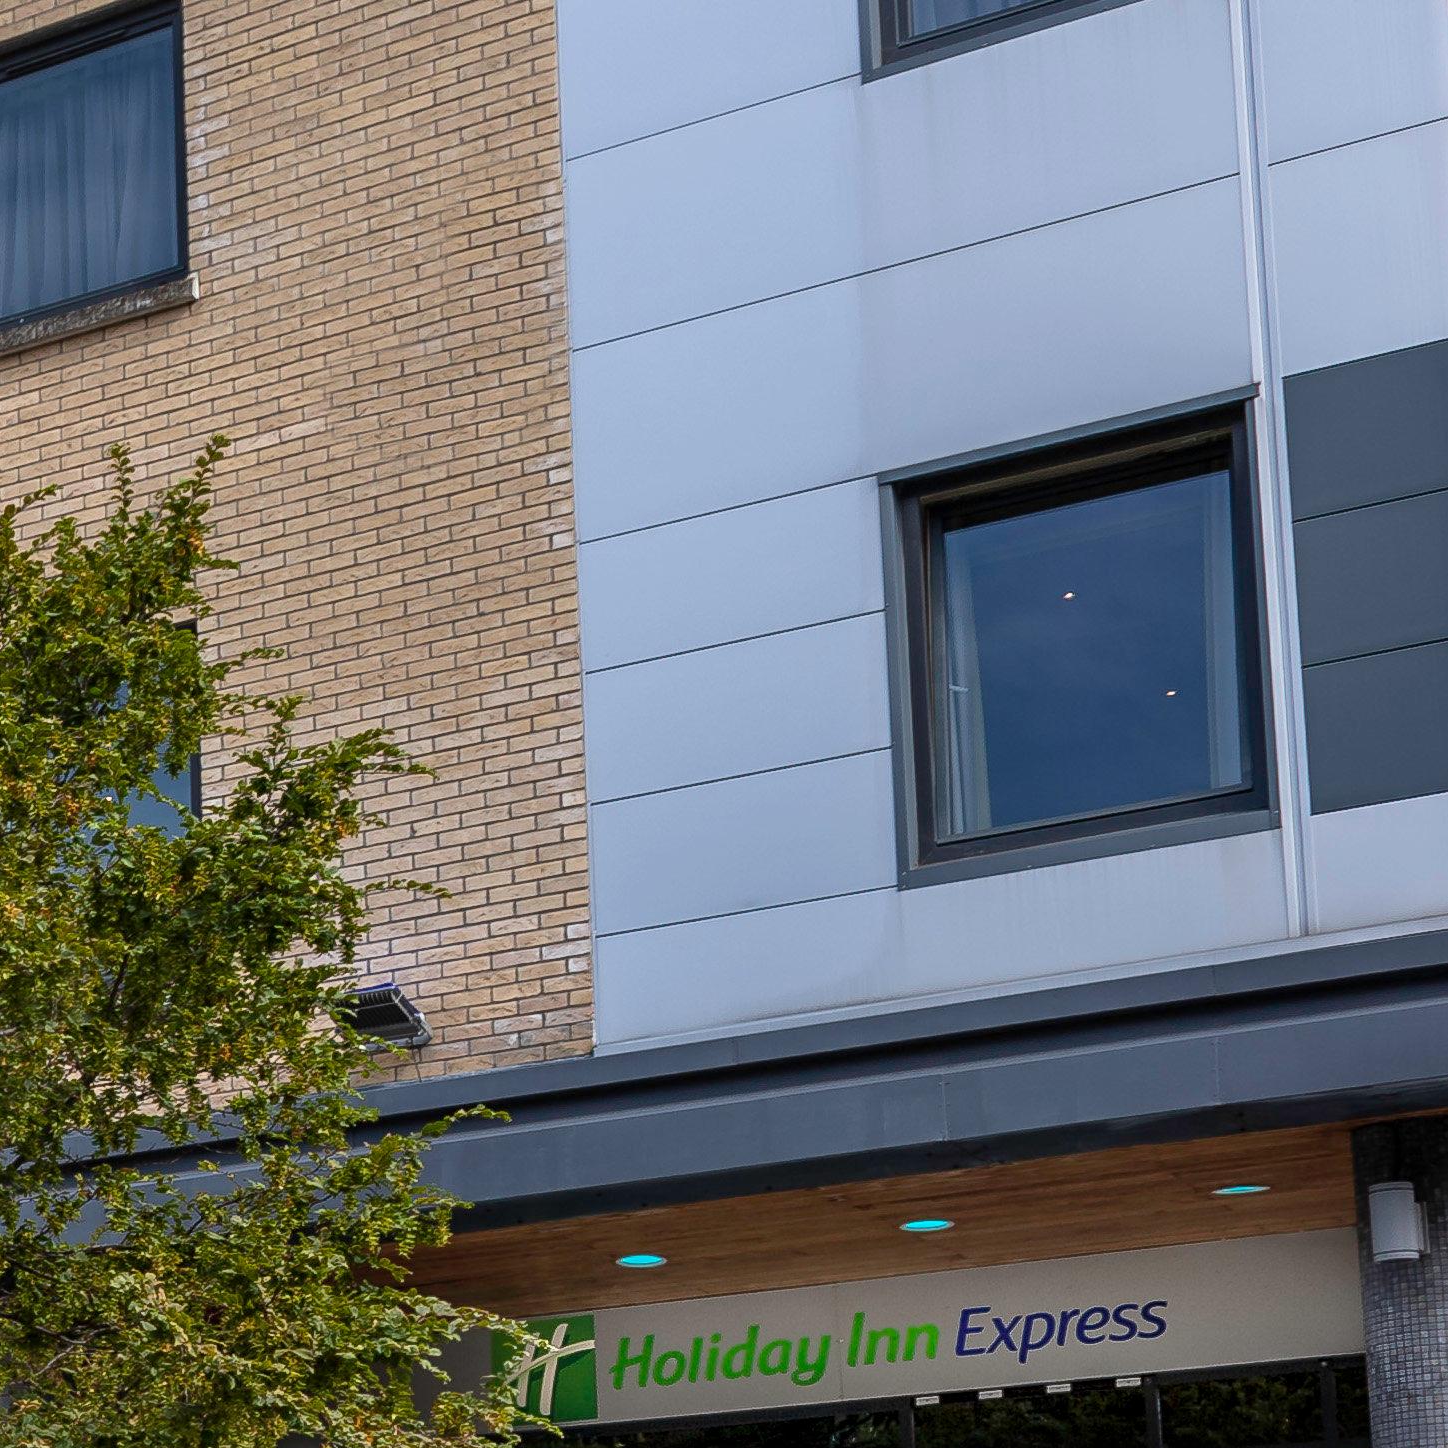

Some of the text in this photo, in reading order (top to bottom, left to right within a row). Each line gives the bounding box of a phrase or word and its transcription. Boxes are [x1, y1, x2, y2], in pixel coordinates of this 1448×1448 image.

[609, 1322, 830, 1390] Holiday
[847, 1312, 940, 1368] Inn
[955, 1299, 1168, 1365] Express
